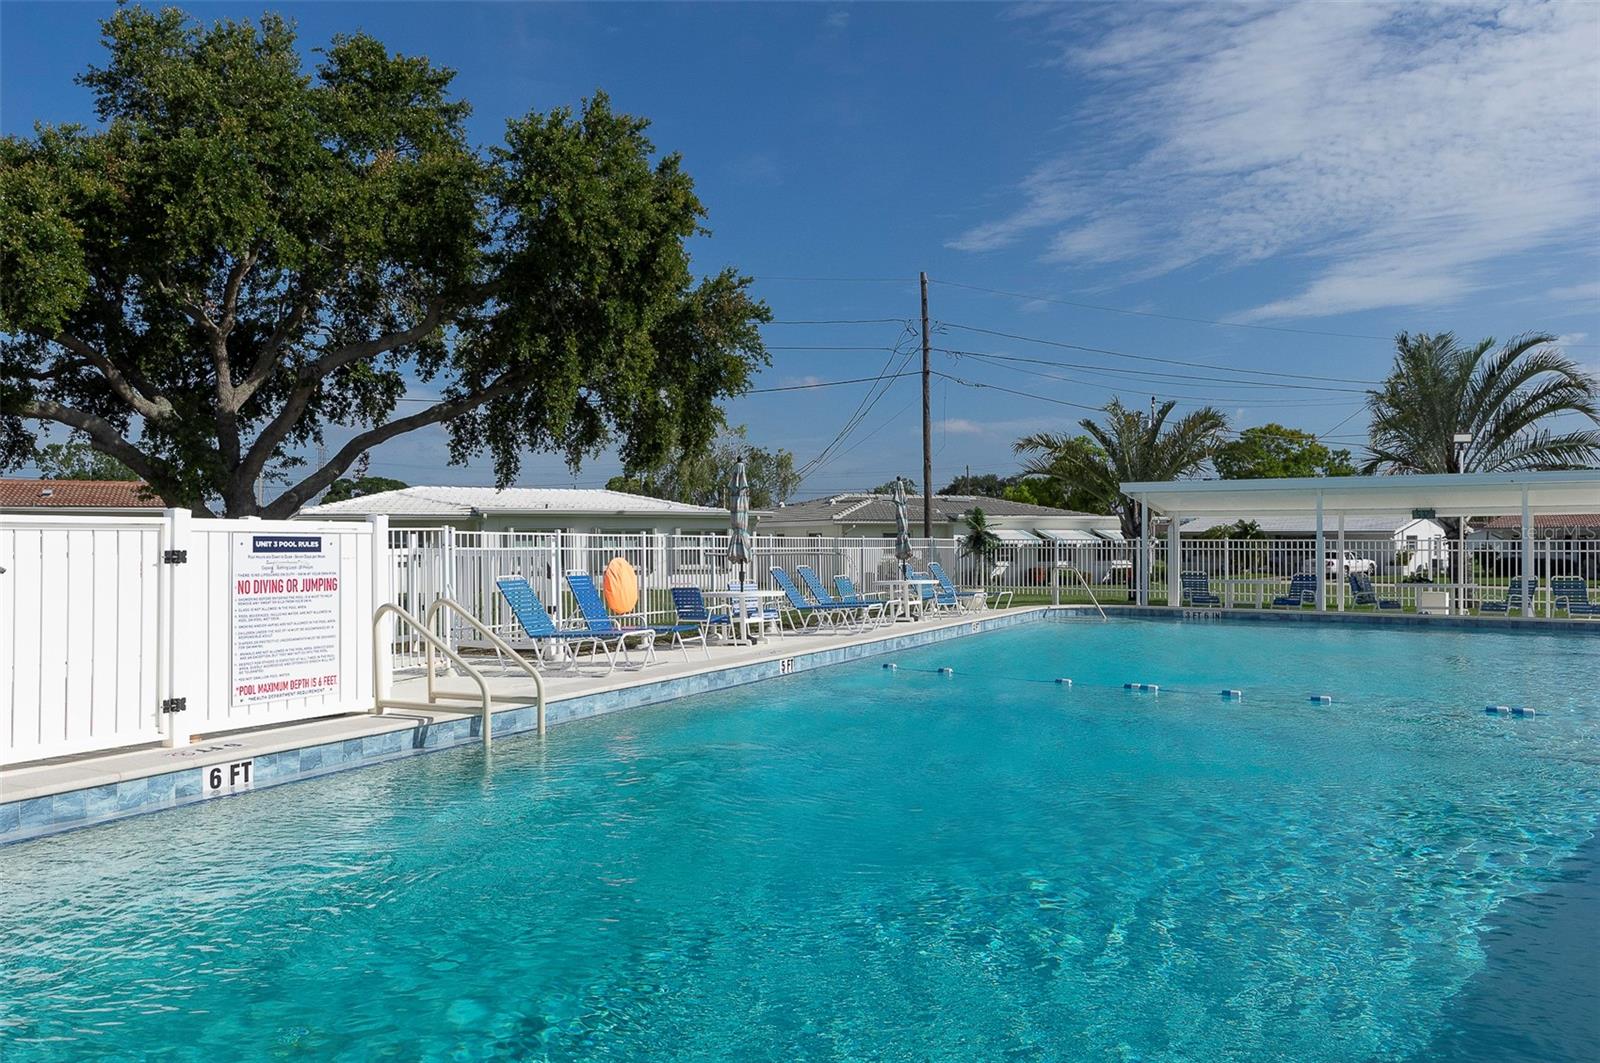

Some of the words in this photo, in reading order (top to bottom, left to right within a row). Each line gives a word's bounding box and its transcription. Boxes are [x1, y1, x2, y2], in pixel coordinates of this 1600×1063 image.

[238, 580, 250, 594] NO
[253, 579, 284, 594] DIVING
[286, 578, 298, 593] OR
[300, 577, 338, 593] JUMPING
[781, 660, 786, 673] 5
[787, 659, 793, 672] FT
[258, 681, 289, 693] MAXIMUM
[290, 678, 310, 690] DEPTH
[311, 677, 317, 687] IS
[318, 676, 322, 687] 6
[210, 768, 222, 790] 6
[230, 761, 252, 786] FT
